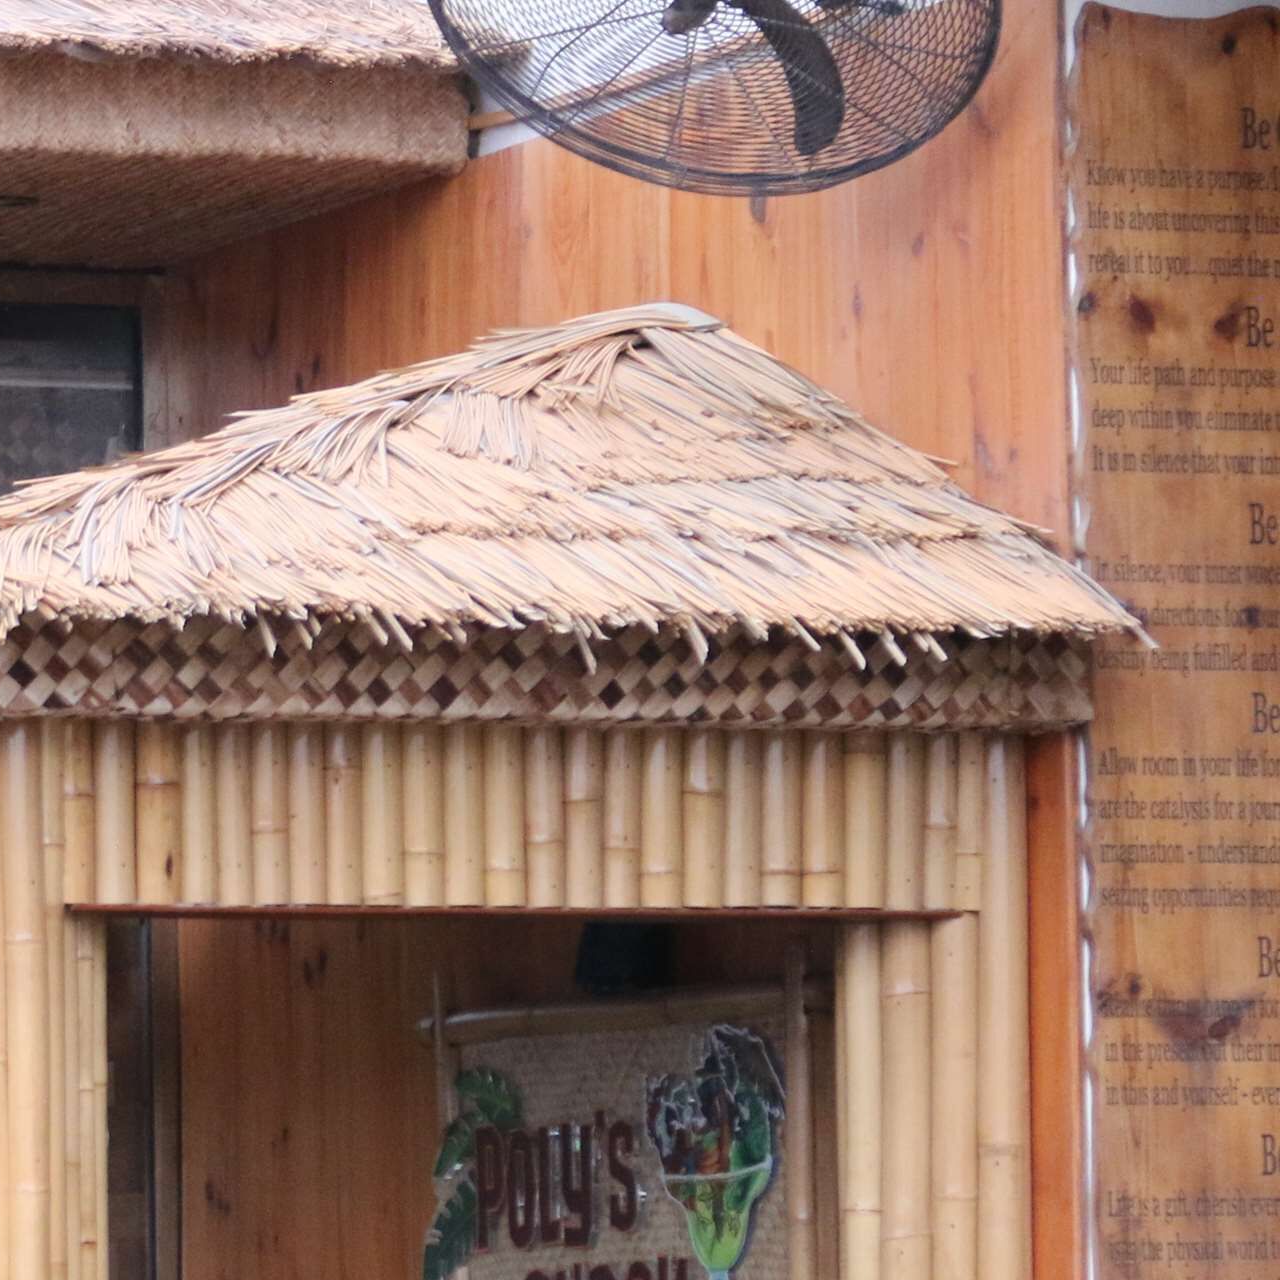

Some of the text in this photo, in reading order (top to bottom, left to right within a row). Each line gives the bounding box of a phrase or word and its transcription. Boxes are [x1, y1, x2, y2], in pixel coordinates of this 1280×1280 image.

[1242, 107, 1272, 150] Be
[1087, 159, 1127, 187] Know
[1128, 202, 1170, 232] about
[1246, 306, 1275, 348] Be
[1091, 358, 1124, 385] Your
[1154, 358, 1186, 393] path
[1190, 359, 1217, 387] and
[1091, 401, 1126, 437] deep
[1128, 401, 1174, 430] within
[1141, 444, 1190, 474] silence
[1249, 503, 1278, 545] Be
[1194, 643, 1247, 672] fulfilled
[1098, 747, 1138, 777] Allow
[1142, 756, 1180, 777] room
[1125, 791, 1147, 821] the
[1213, 791, 1234, 821] for
[1122, 1034, 1144, 1062] the
[1152, 1077, 1179, 1105] and
